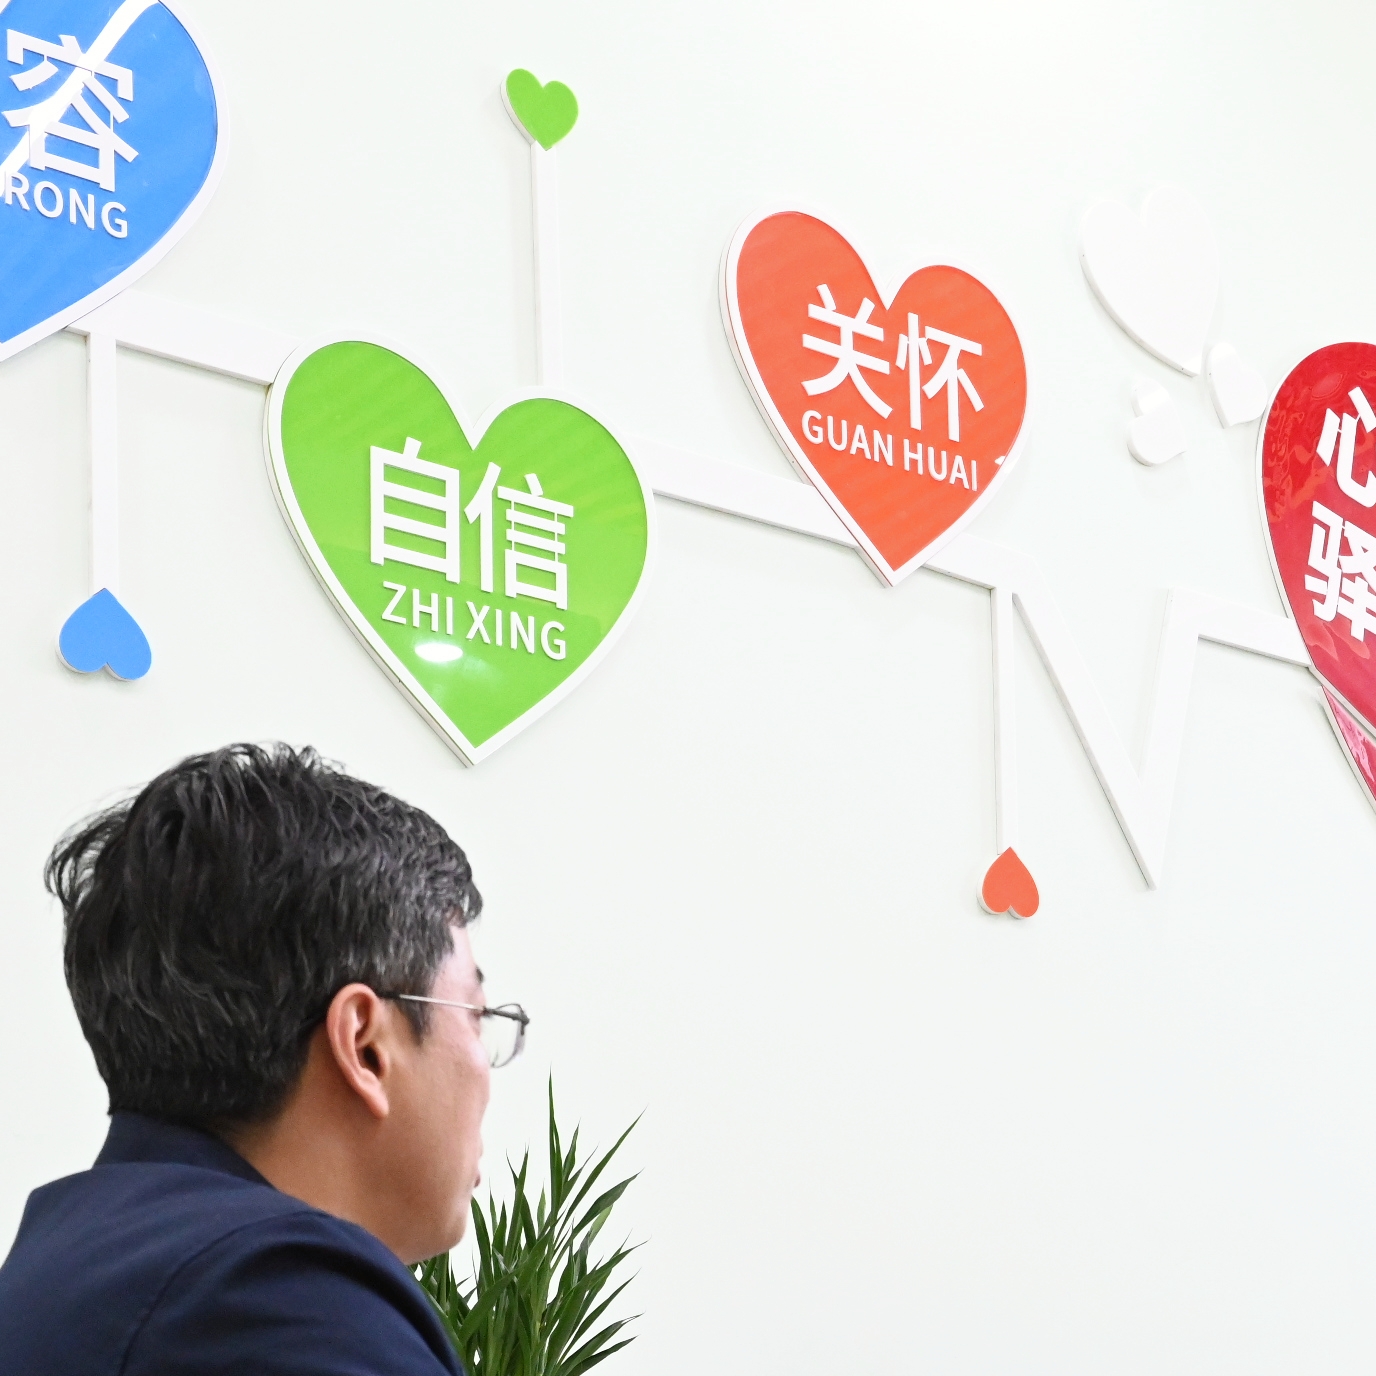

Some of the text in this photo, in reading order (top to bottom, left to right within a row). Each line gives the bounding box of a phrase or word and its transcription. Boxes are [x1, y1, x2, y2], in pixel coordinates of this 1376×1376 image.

[4, 171, 128, 239] RONG
[801, 283, 984, 442] 关怀
[801, 409, 978, 492] GUAN HUAI
[369, 437, 574, 611] 自信
[381, 580, 567, 660] ZHI XING
